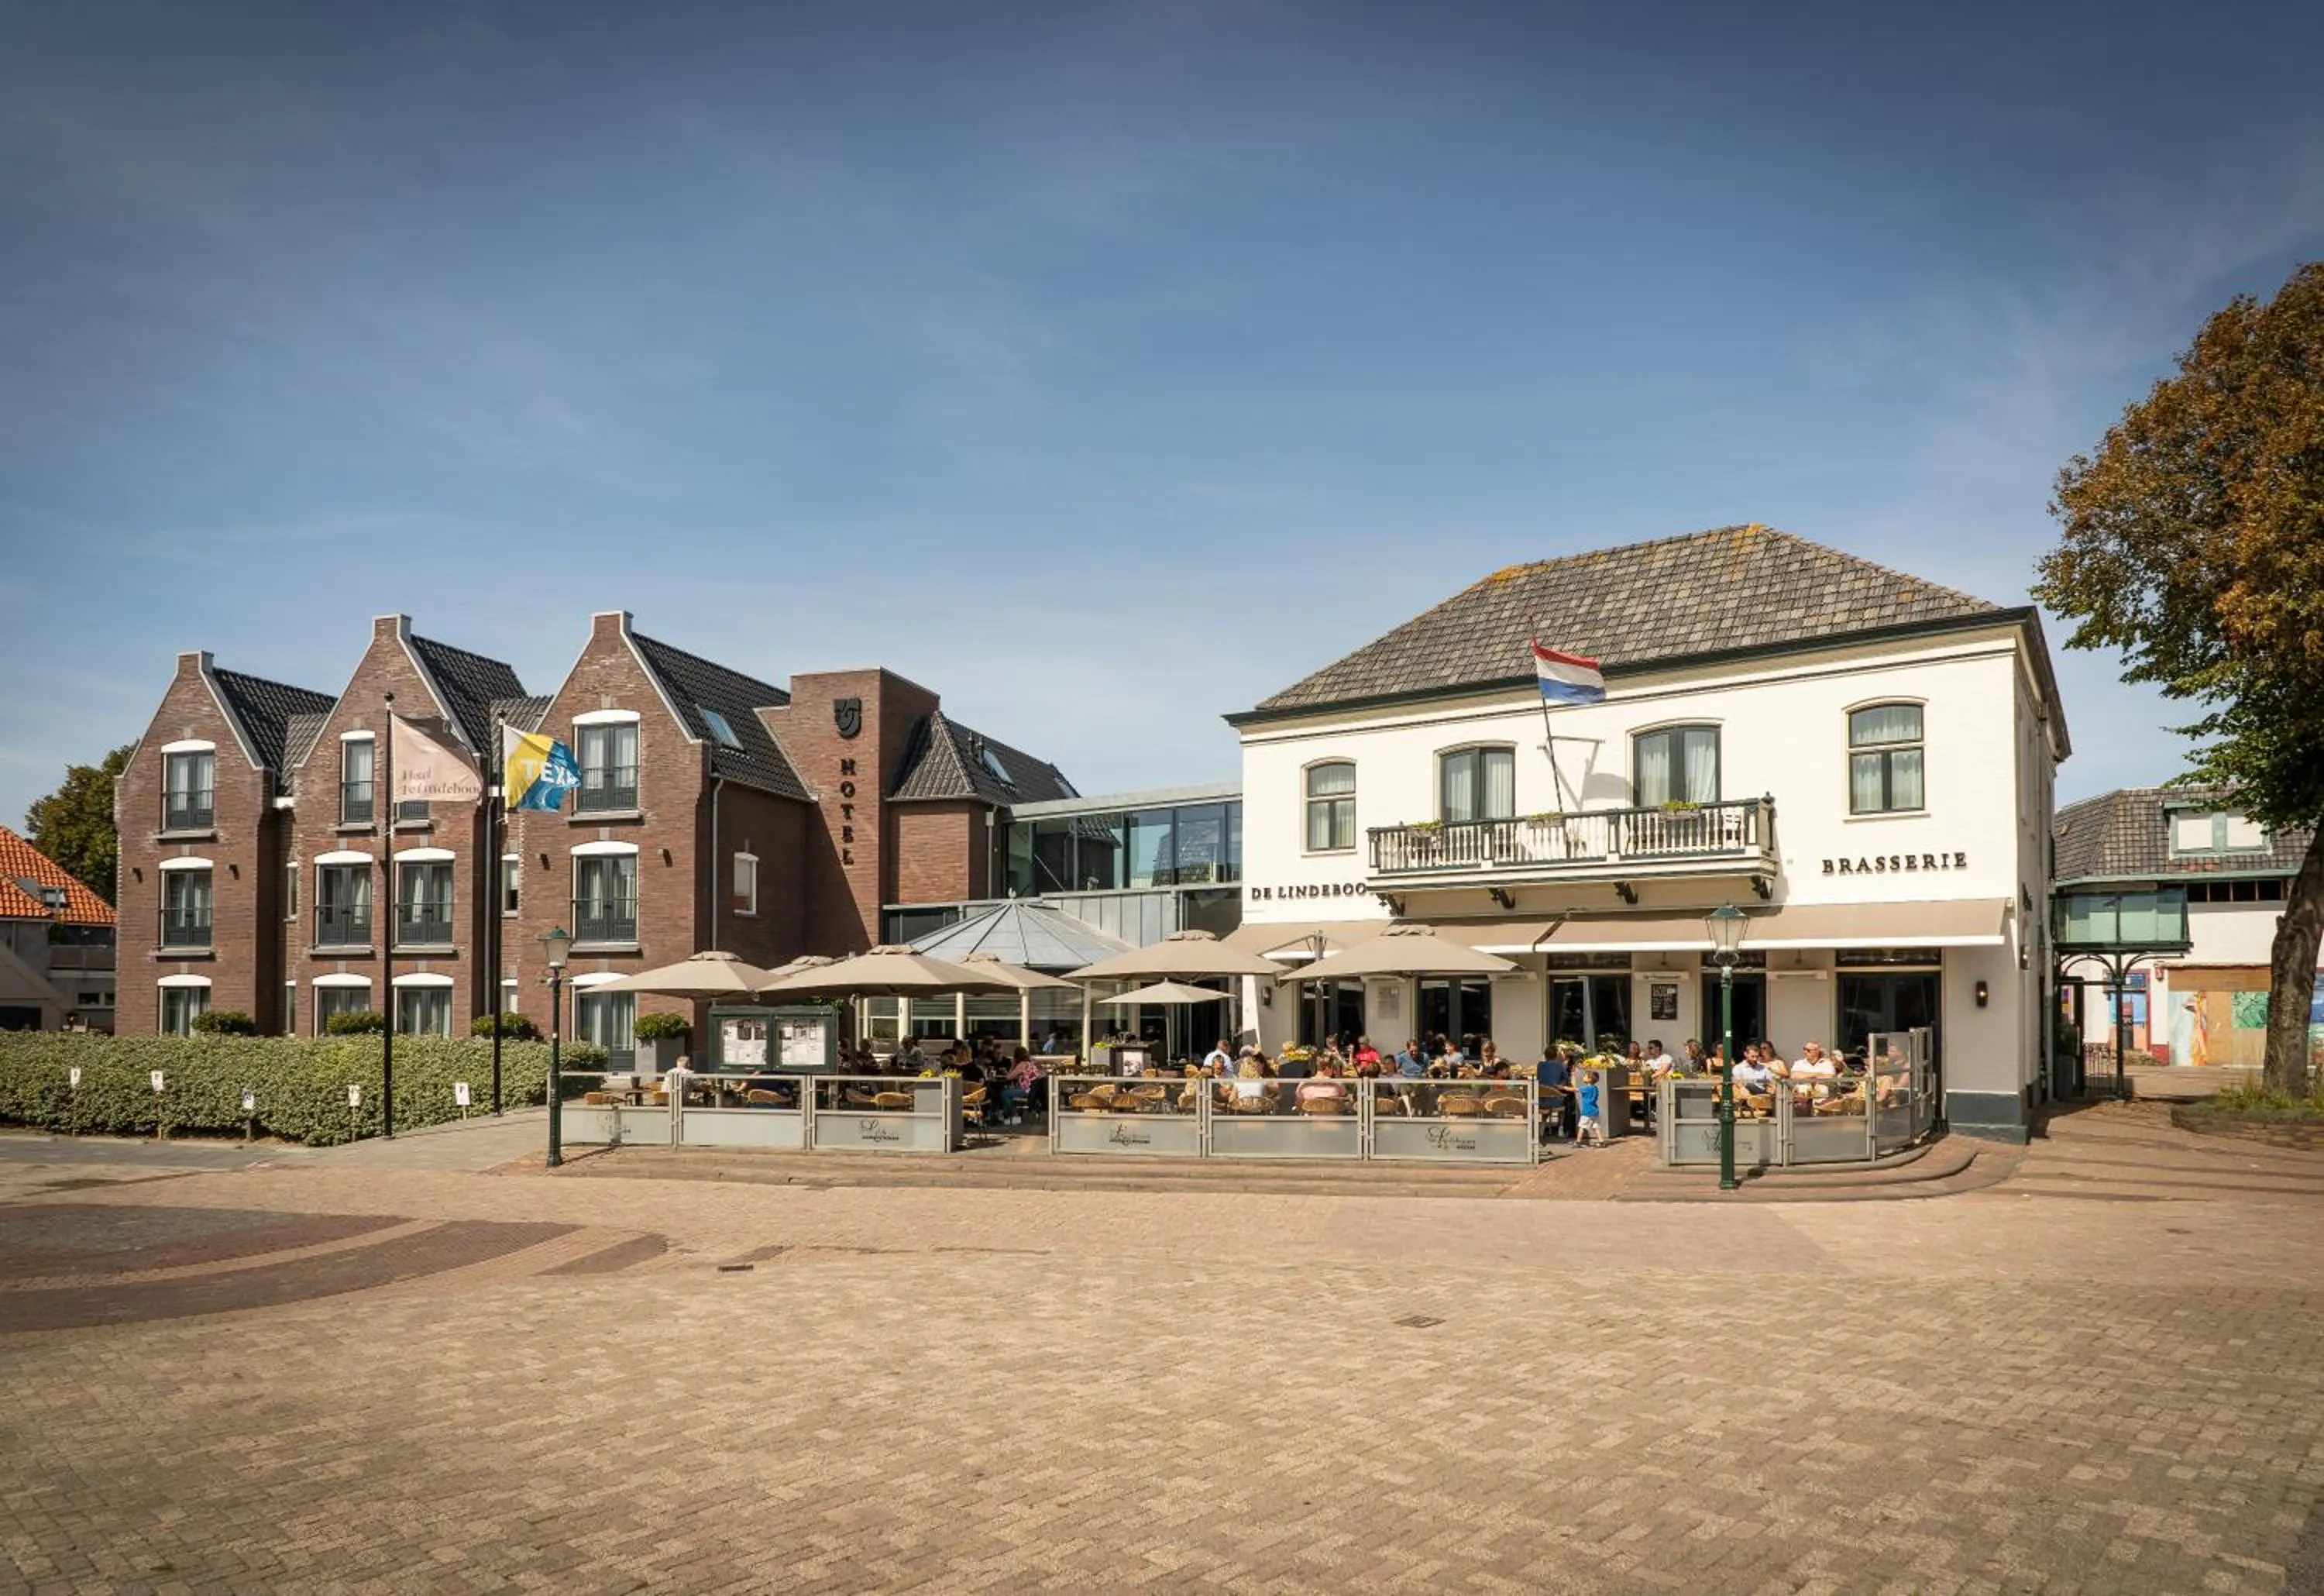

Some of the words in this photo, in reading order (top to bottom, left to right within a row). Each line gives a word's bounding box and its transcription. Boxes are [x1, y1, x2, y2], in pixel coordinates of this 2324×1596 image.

[840, 758, 856, 865] HOTEL
[1821, 852, 1968, 875] BRASSERIE
[1251, 886, 1272, 901] DE
[1277, 882, 1367, 900] LINDEBOO
